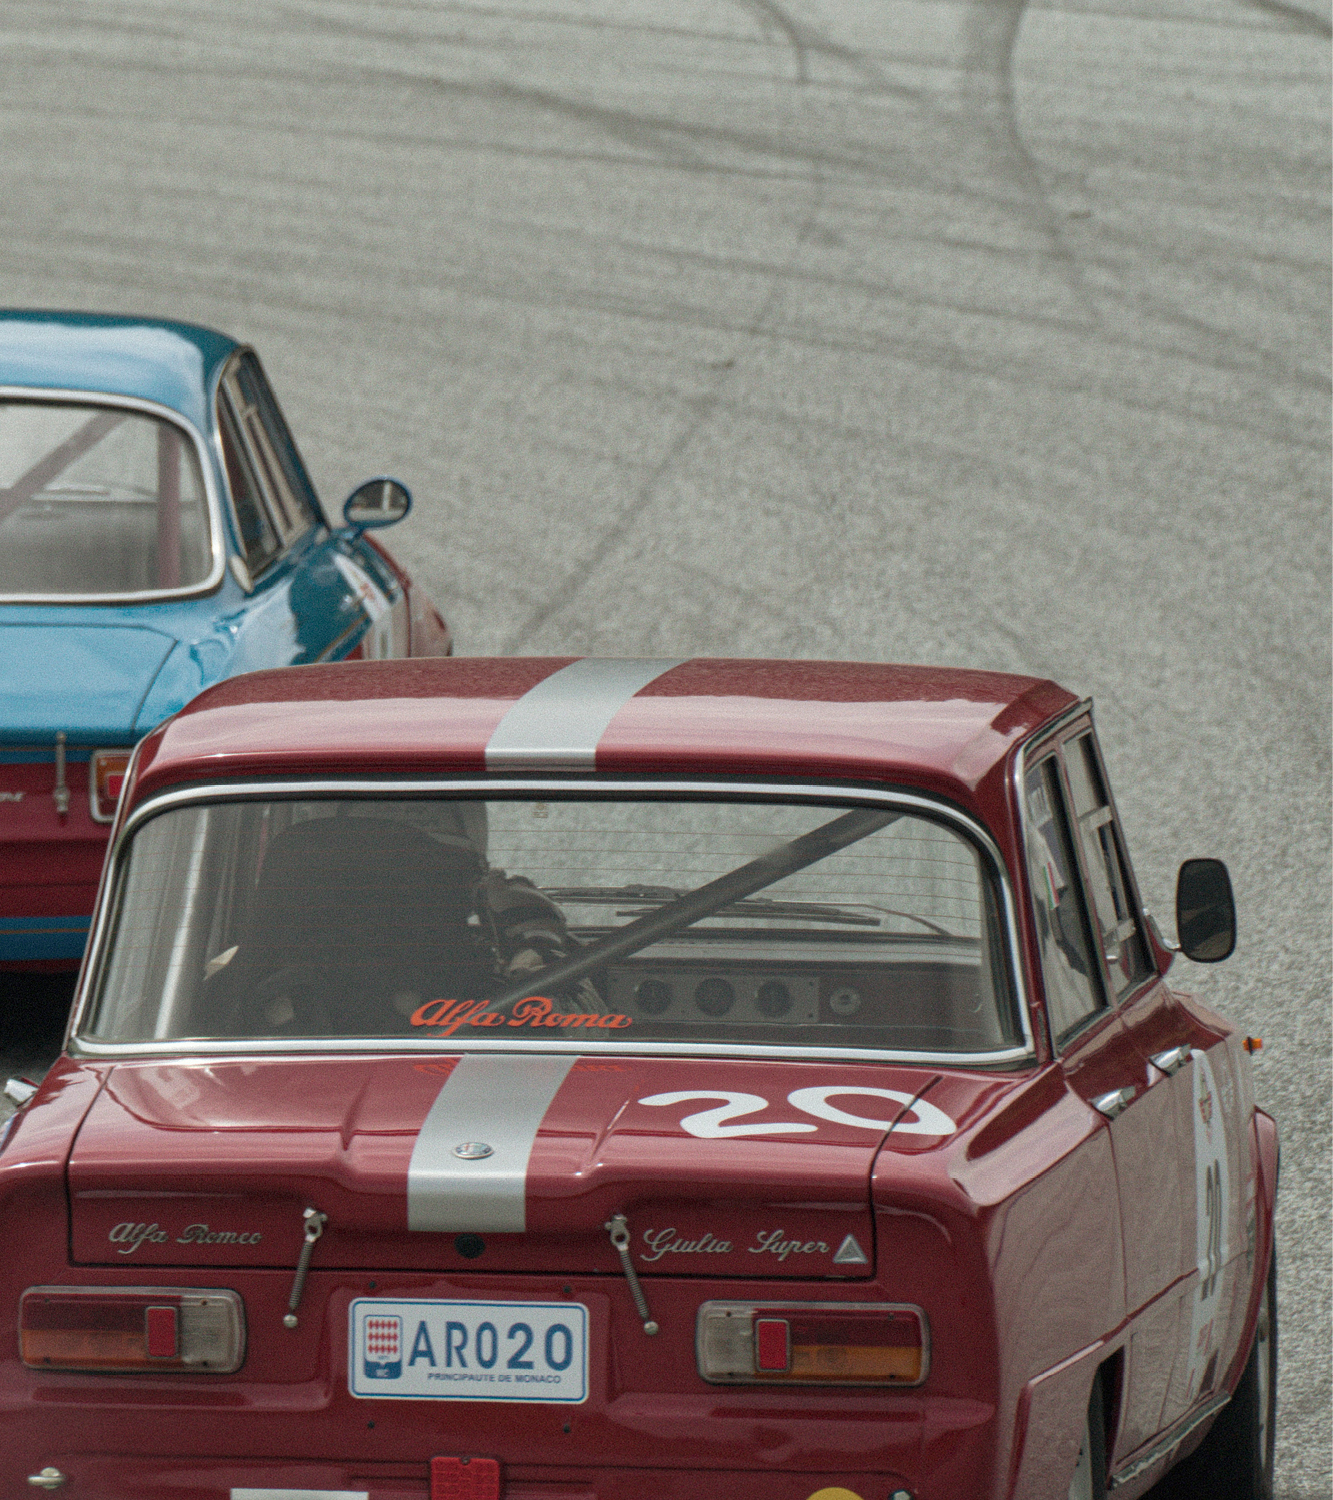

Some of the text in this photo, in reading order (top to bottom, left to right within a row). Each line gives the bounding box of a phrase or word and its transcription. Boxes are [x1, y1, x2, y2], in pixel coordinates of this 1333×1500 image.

[410, 996, 633, 1037] Alfa Roma
[638, 1086, 957, 1138] 20
[109, 1222, 263, 1254] Alfa Romeo
[640, 1227, 830, 1262] Giulia Super
[408, 1320, 573, 1371] AR020
[427, 1372, 562, 1384] PRINCIPAUTE DE MONACO
